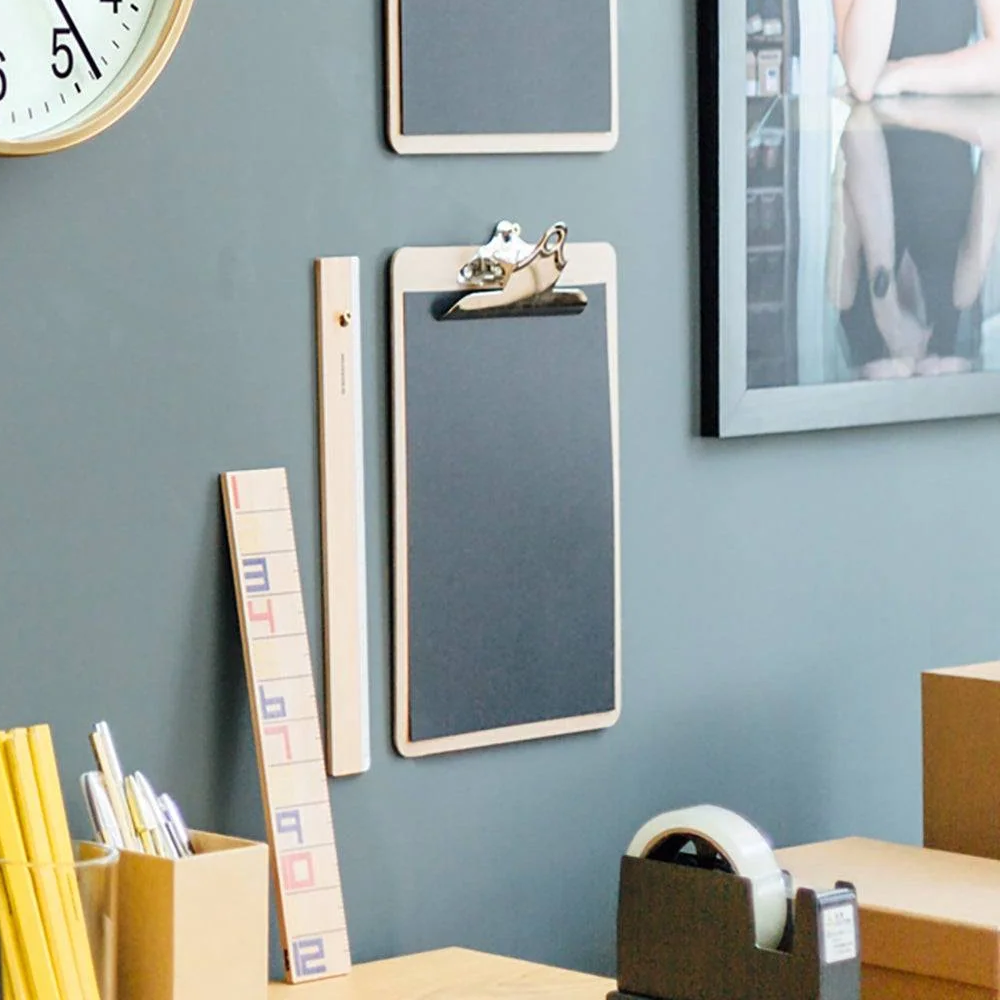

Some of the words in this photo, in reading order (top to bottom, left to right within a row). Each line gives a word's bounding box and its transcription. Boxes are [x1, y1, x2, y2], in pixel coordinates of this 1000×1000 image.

[50, 27, 72, 79] 5
[242, 557, 270, 593] 3
[247, 598, 275, 634] 4
[264, 724, 293, 760] 7
[275, 808, 304, 844] 9
[291, 937, 327, 977] 12
